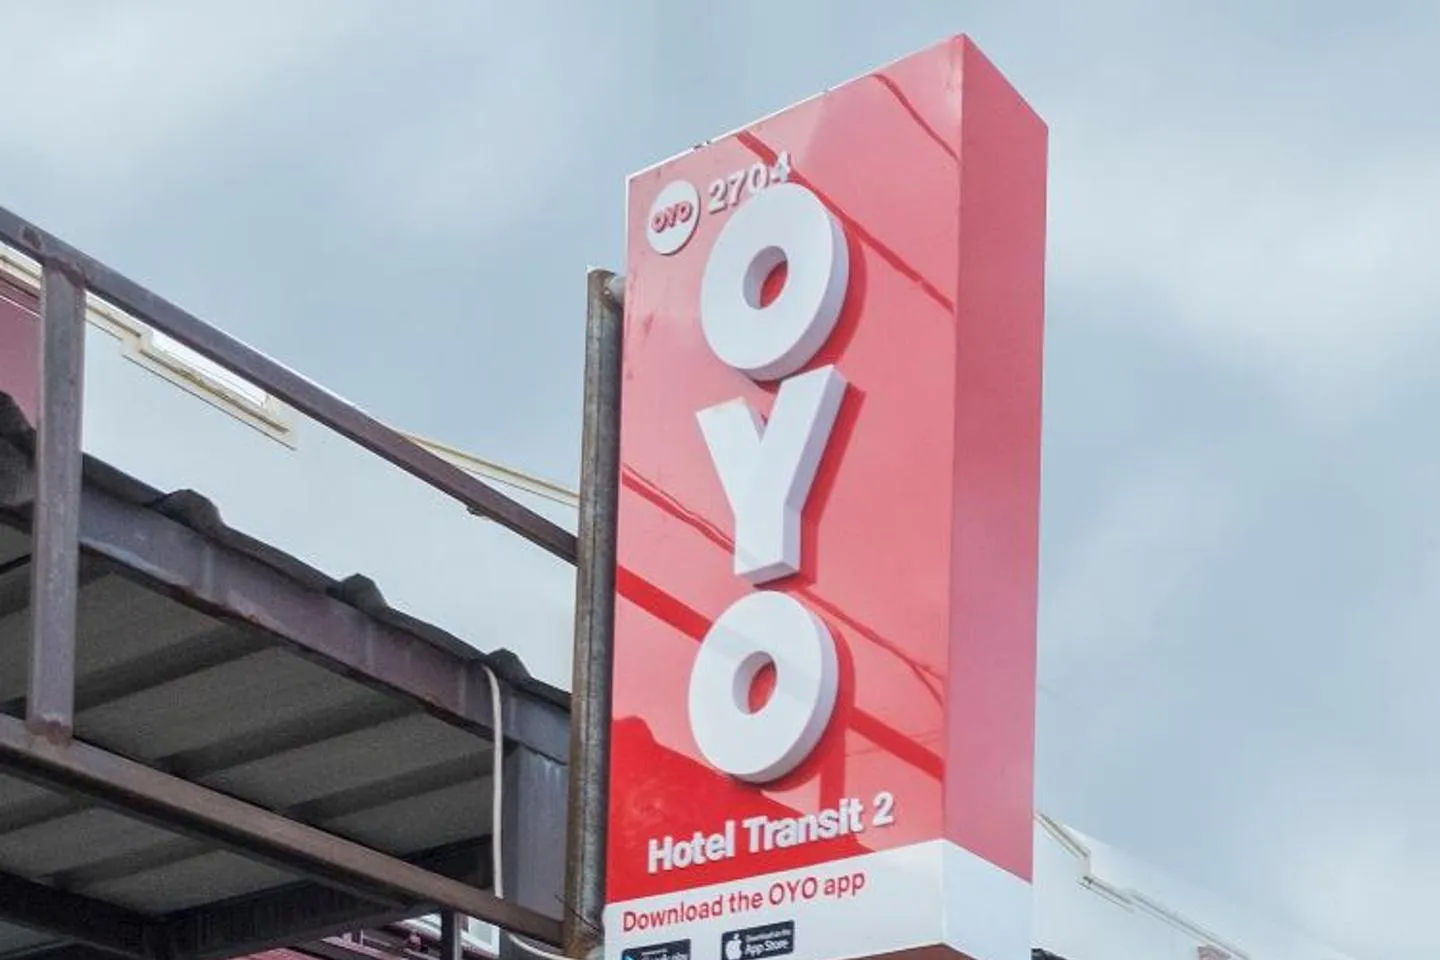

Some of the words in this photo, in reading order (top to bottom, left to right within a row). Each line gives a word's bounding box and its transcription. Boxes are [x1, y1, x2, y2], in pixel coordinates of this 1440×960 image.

[650, 202, 693, 234] OYO
[707, 151, 793, 215] 2704
[687, 181, 850, 785] OYO
[648, 820, 736, 874] Hotel
[742, 796, 865, 854] Transit
[872, 791, 895, 827] 2
[623, 900, 724, 933] Download
[729, 888, 764, 914] the
[769, 876, 819, 907] OYO
[823, 872, 866, 899] app
